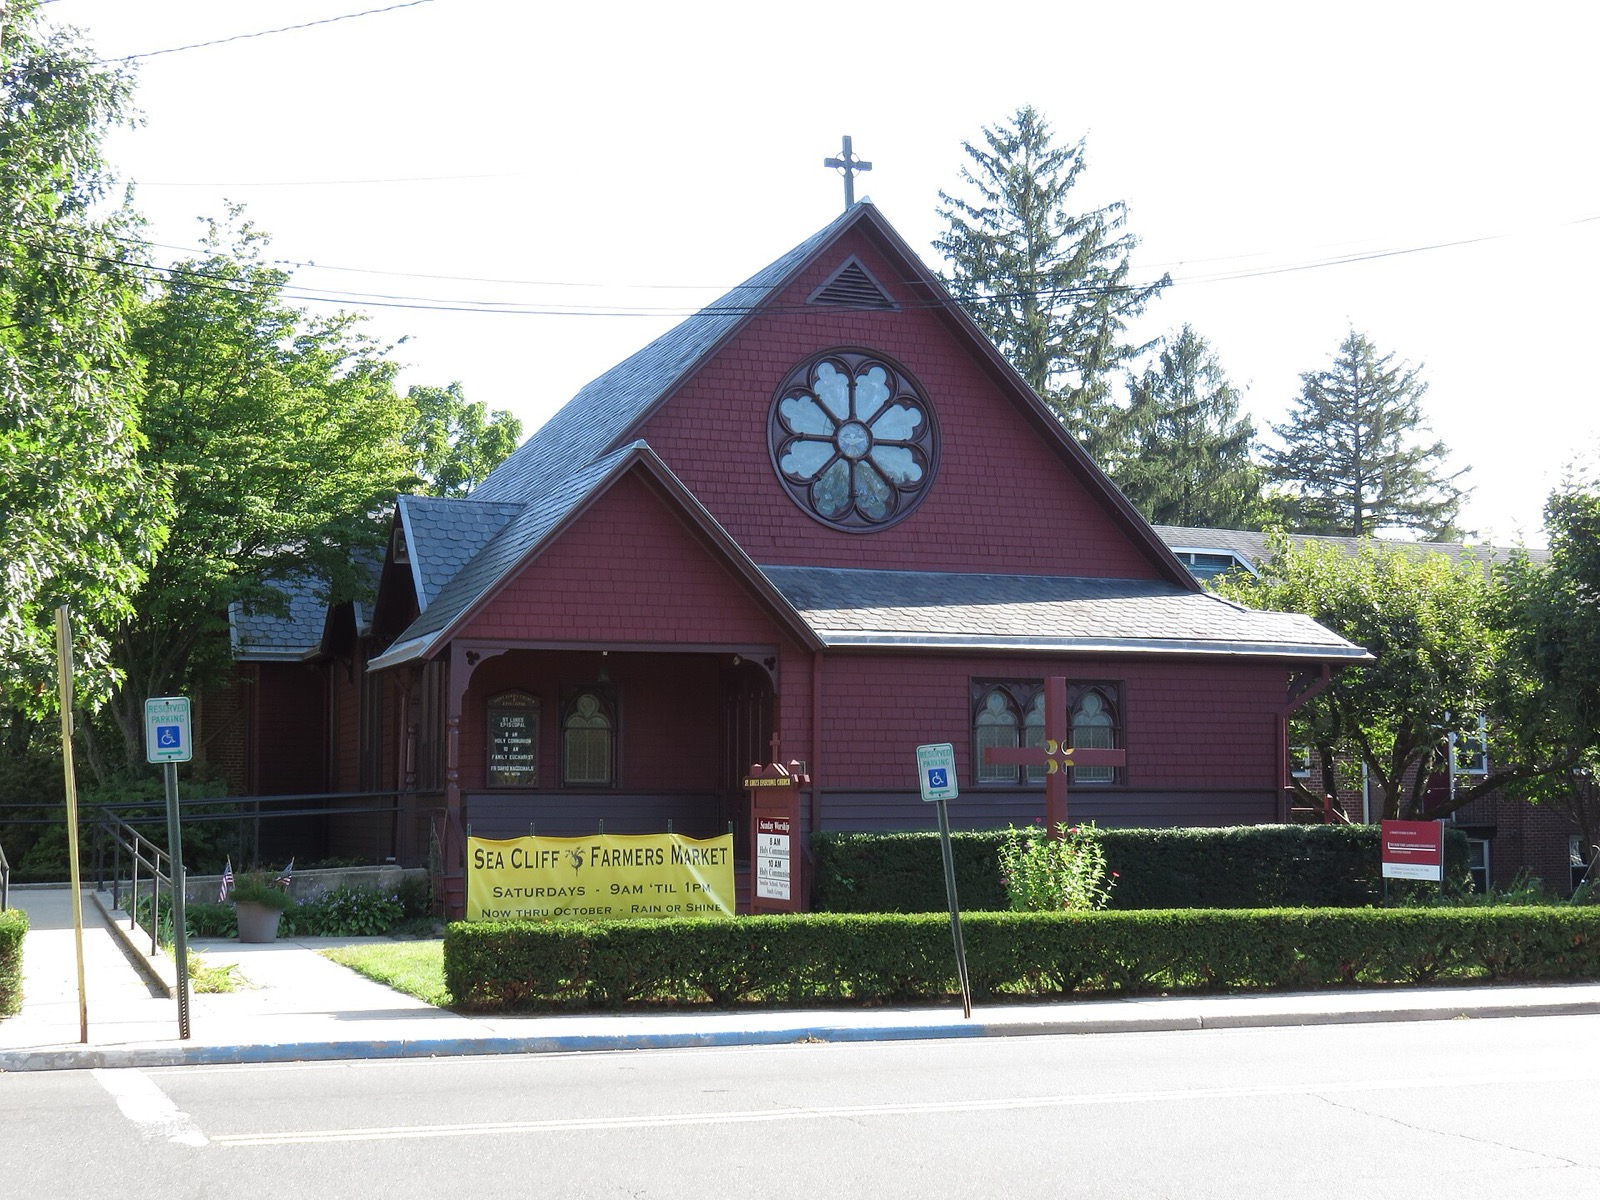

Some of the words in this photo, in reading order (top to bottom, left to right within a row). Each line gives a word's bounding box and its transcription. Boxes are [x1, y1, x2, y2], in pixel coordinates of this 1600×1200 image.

[148, 704, 187, 713] RESERVED
[151, 715, 185, 723] PARKING
[920, 749, 951, 758] RESERVED
[922, 759, 950, 767] PARKING
[760, 821, 774, 832] Sunday
[774, 821, 790, 833] Worship
[769, 837, 773, 846] 8
[774, 837, 781, 846] AM
[759, 846, 768, 856] Holy
[474, 848, 504, 869] SEA
[511, 847, 560, 869] CLIFF
[591, 846, 664, 867] FARMERS
[671, 845, 728, 865] MARKET
[768, 859, 773, 868] 10
[774, 860, 782, 868] AM
[493, 886, 586, 898] SATURDAYS
[610, 883, 643, 895] 9AM
[649, 883, 677, 893] 'TIL
[685, 882, 711, 893] 1PM
[482, 909, 511, 918] NOW
[516, 909, 549, 917] THRU
[553, 907, 612, 916] OCTOBER
[631, 904, 661, 913] RAIN
[666, 904, 681, 913] OR
[686, 903, 721, 912] SHINE
